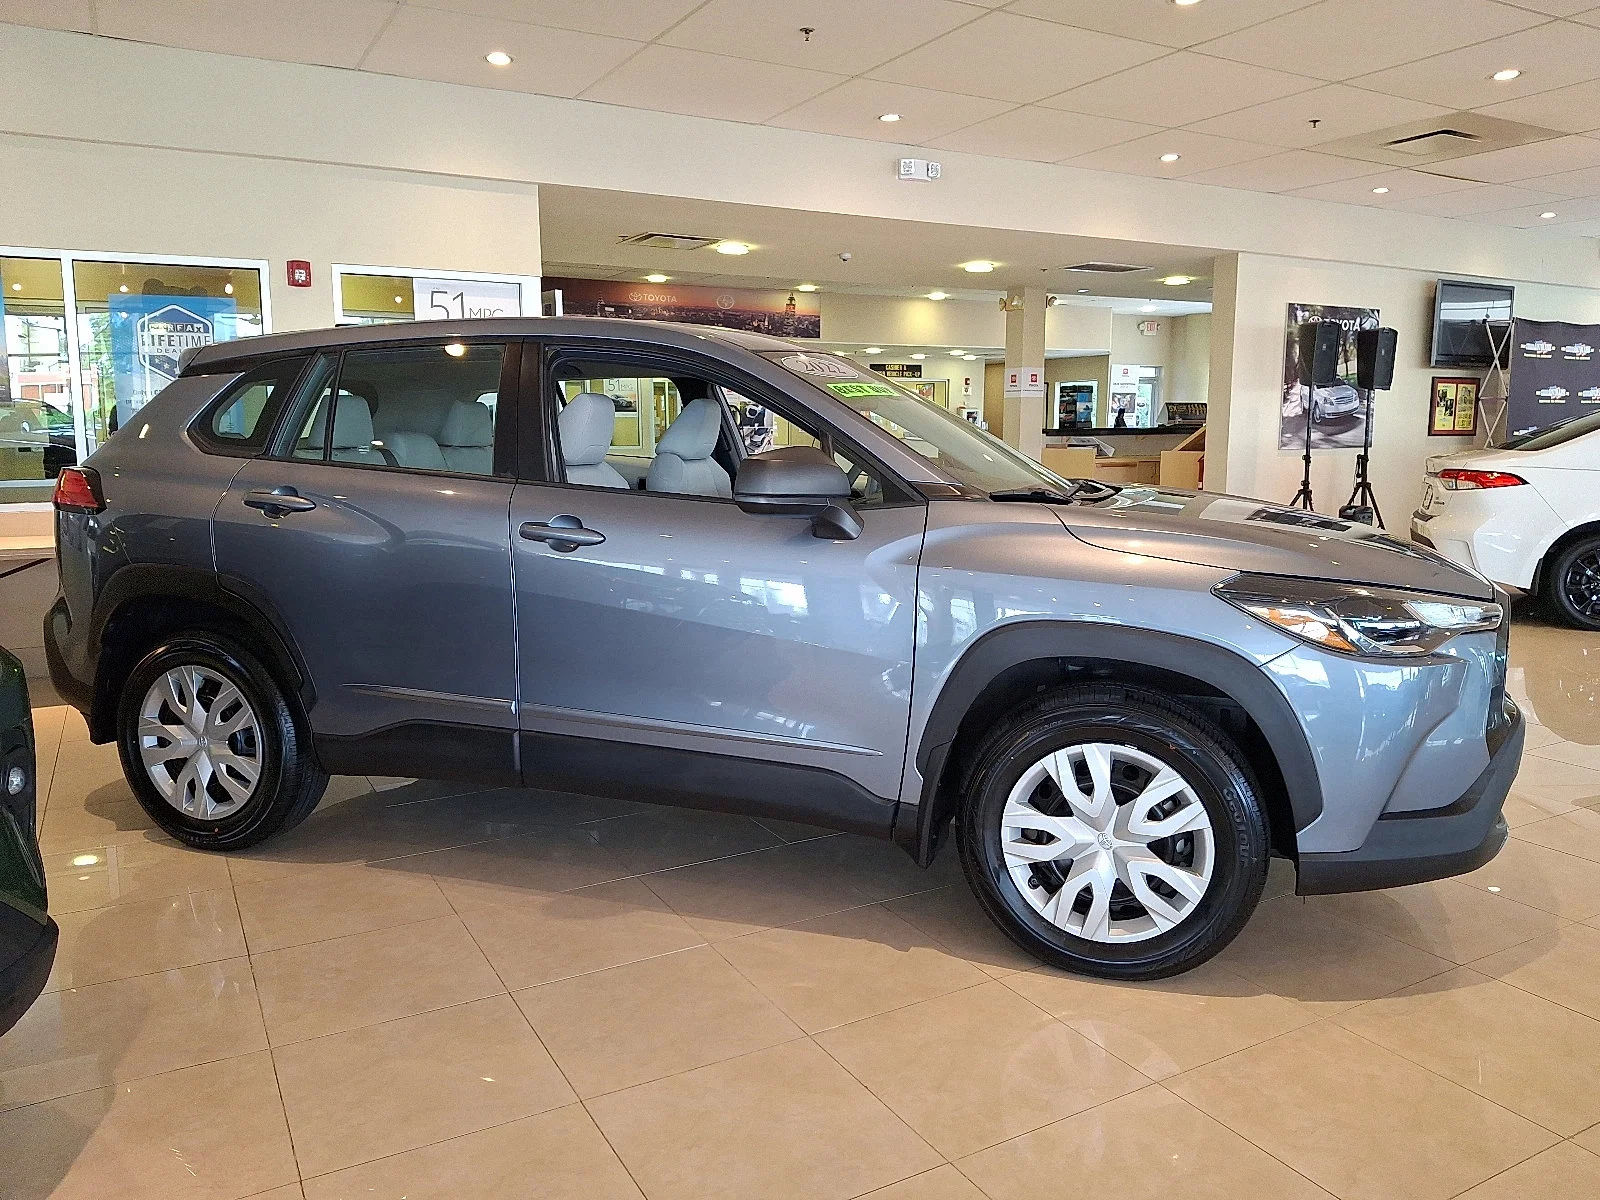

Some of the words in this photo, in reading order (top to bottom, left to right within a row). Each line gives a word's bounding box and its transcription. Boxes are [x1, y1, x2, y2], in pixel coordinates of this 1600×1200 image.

[642, 293, 678, 303] TOYOTA
[430, 290, 465, 319] 51
[149, 322, 204, 334] RFAX
[1323, 317, 1361, 331] OTA
[832, 384, 871, 395] BEST
